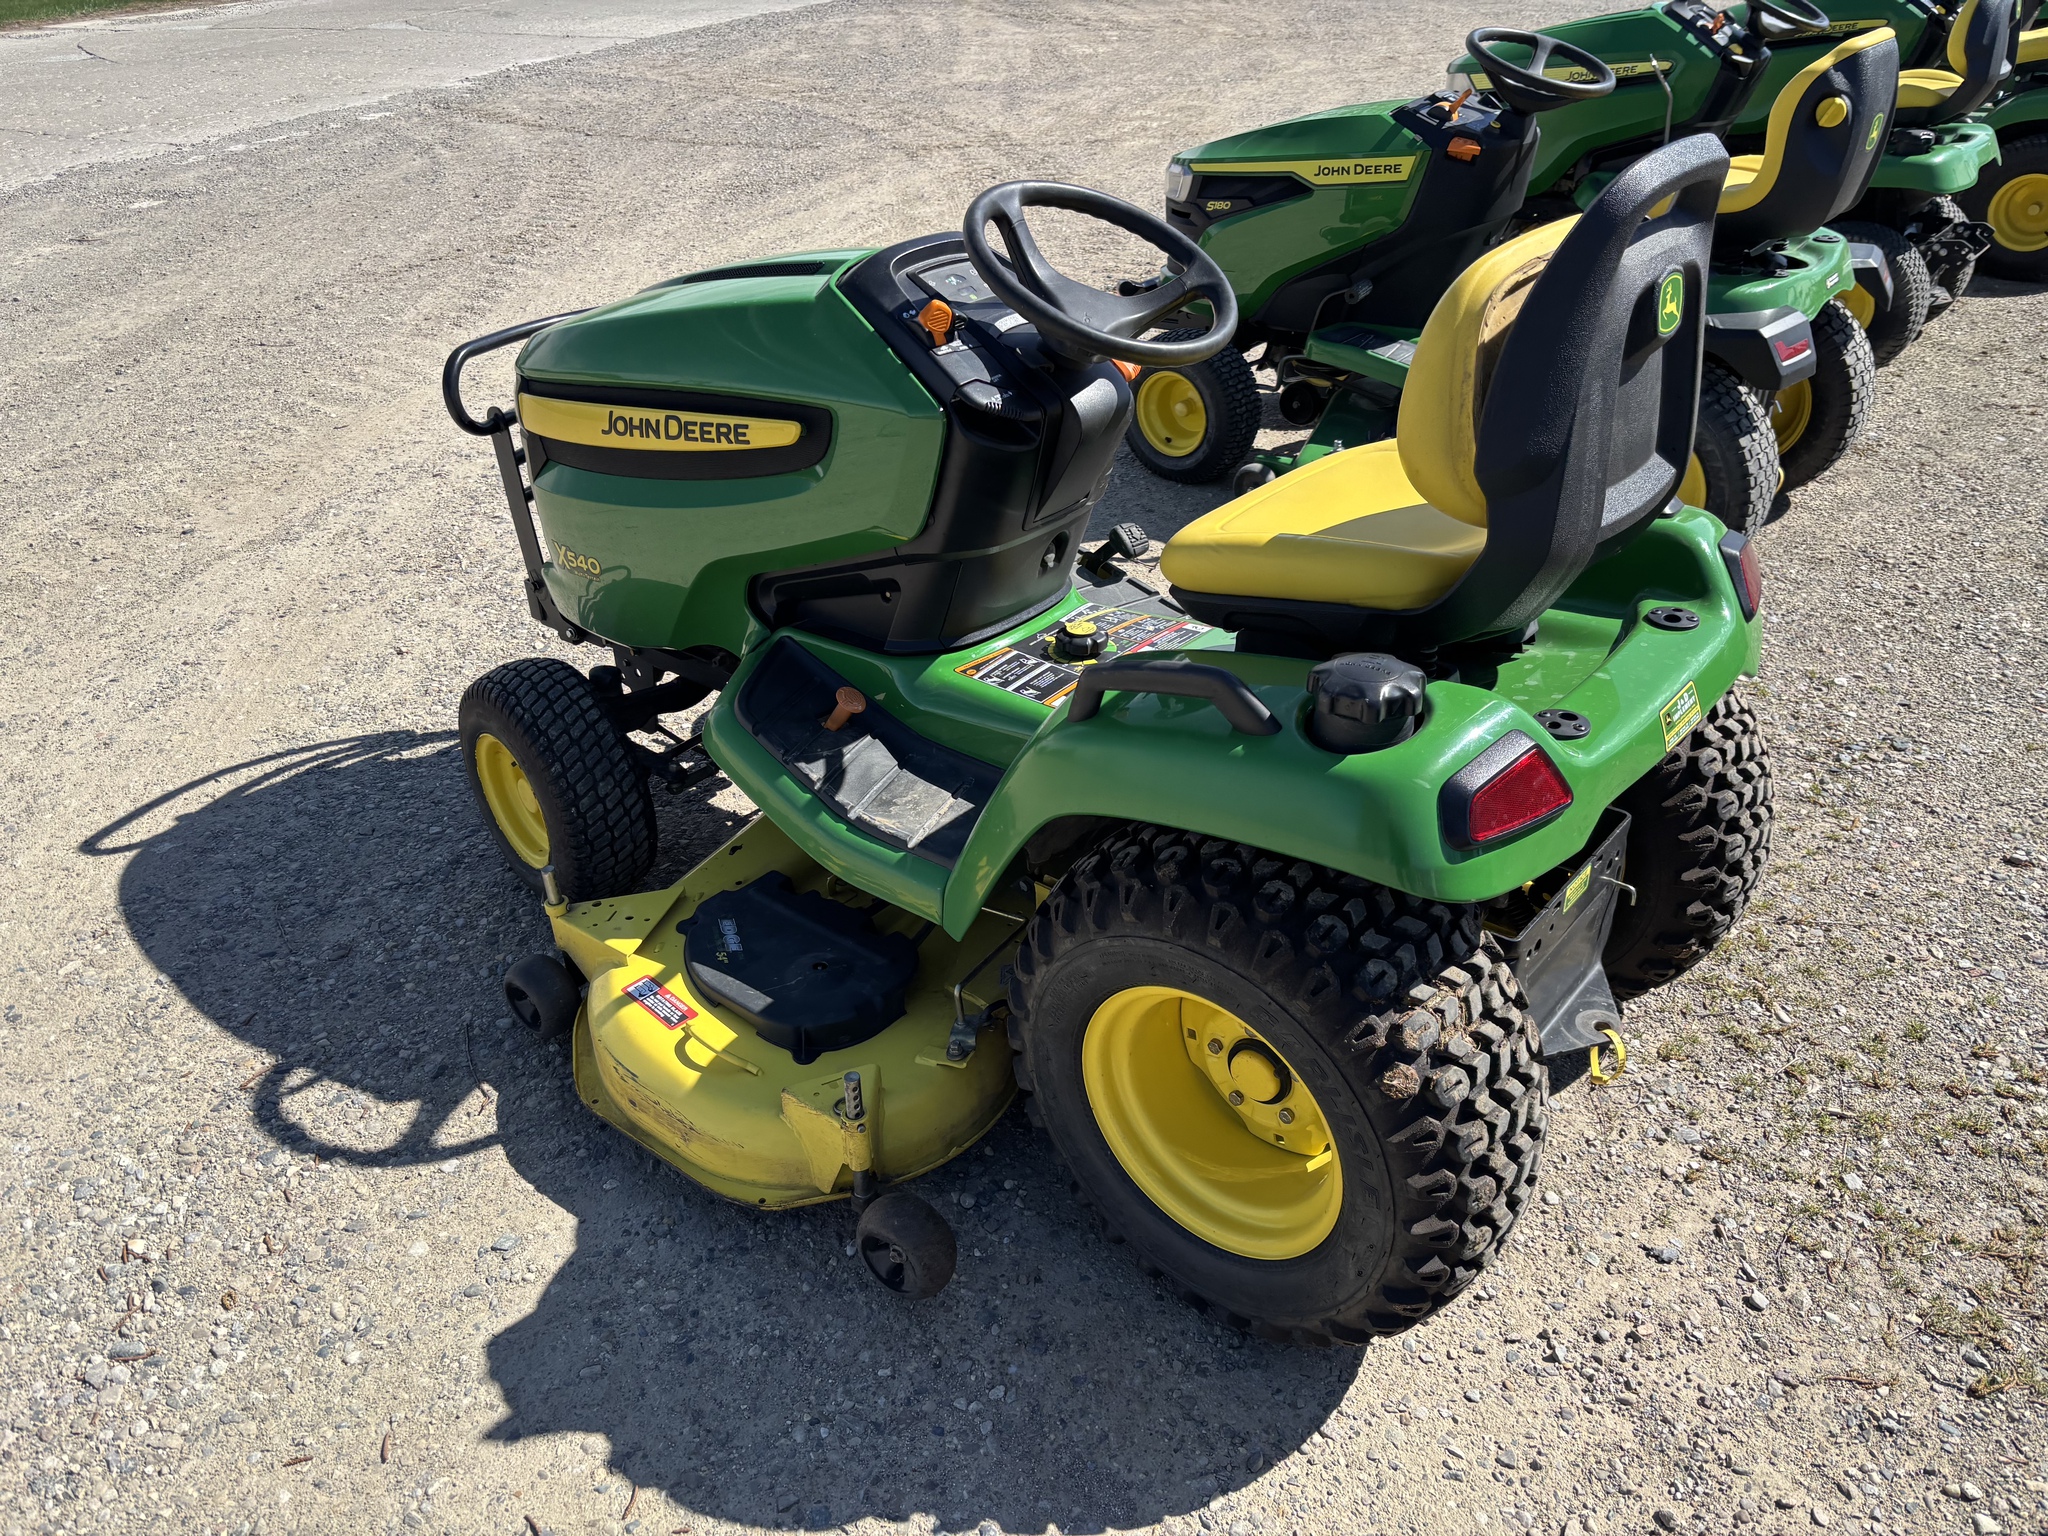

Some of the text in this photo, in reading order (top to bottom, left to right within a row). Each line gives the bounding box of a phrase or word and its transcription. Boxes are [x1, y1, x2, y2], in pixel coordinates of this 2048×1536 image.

[1314, 163, 1402, 177] JOHN DEERE
[1206, 201, 1231, 211] S180
[601, 410, 750, 446] JOHN DEERE
[551, 538, 602, 576] X540
[717, 918, 744, 953] EDGE
[669, 996, 688, 1012] DANGER
